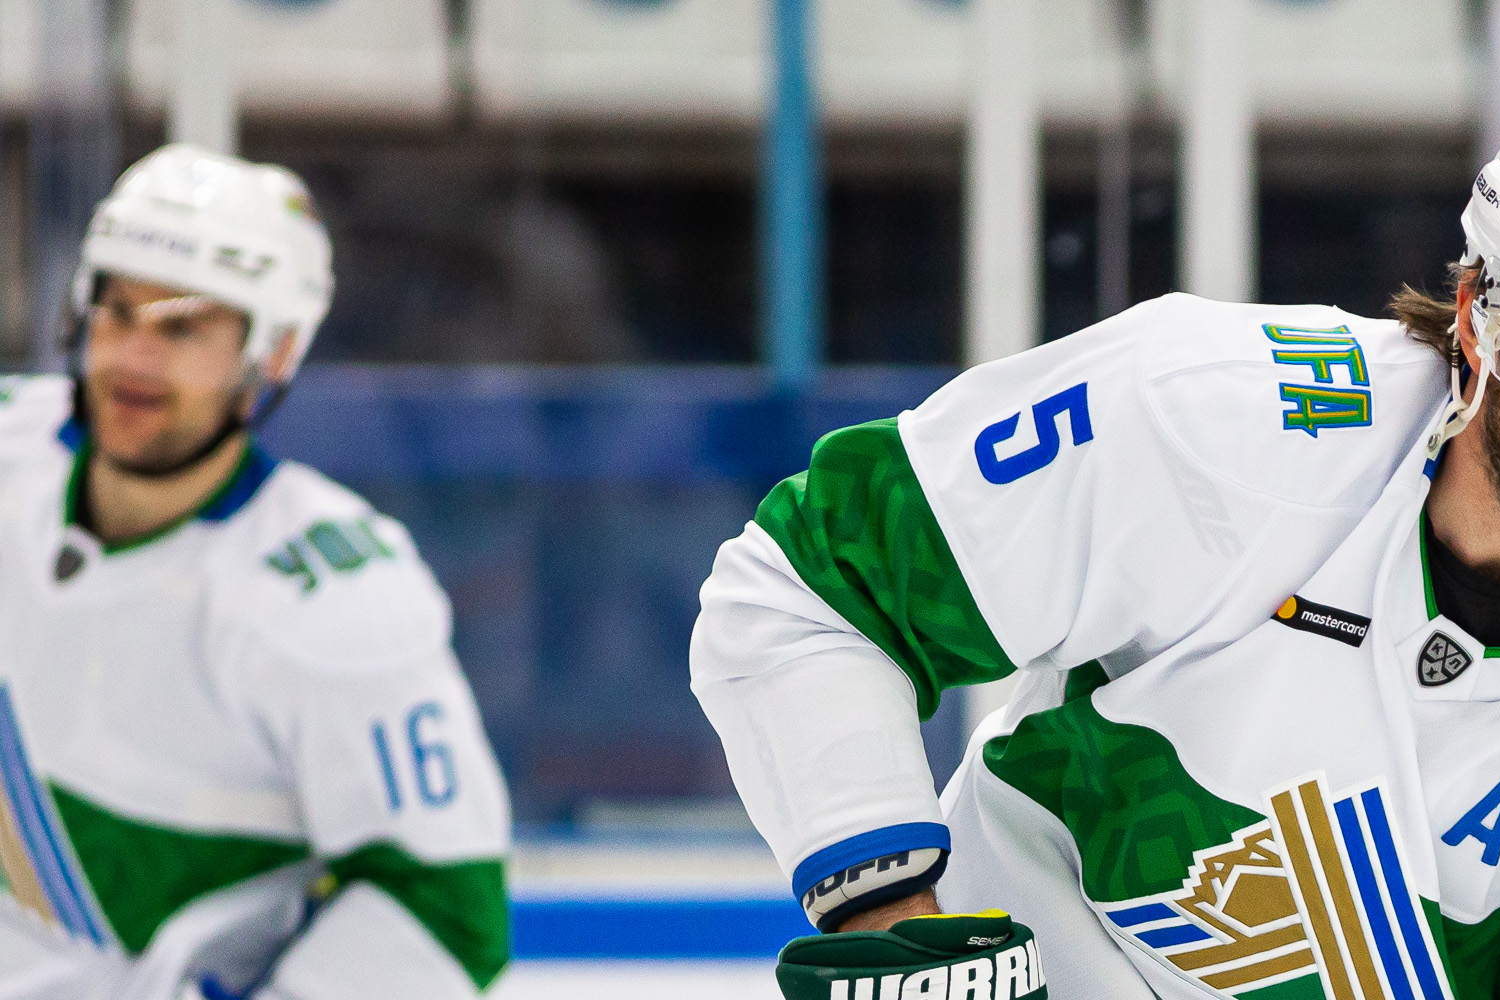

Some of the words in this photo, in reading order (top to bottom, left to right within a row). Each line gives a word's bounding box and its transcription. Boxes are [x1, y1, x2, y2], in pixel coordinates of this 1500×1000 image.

[974, 380, 1095, 485] 5
[1261, 322, 1373, 439] UFA
[1300, 609, 1368, 638] mastercard
[370, 701, 459, 813] 16
